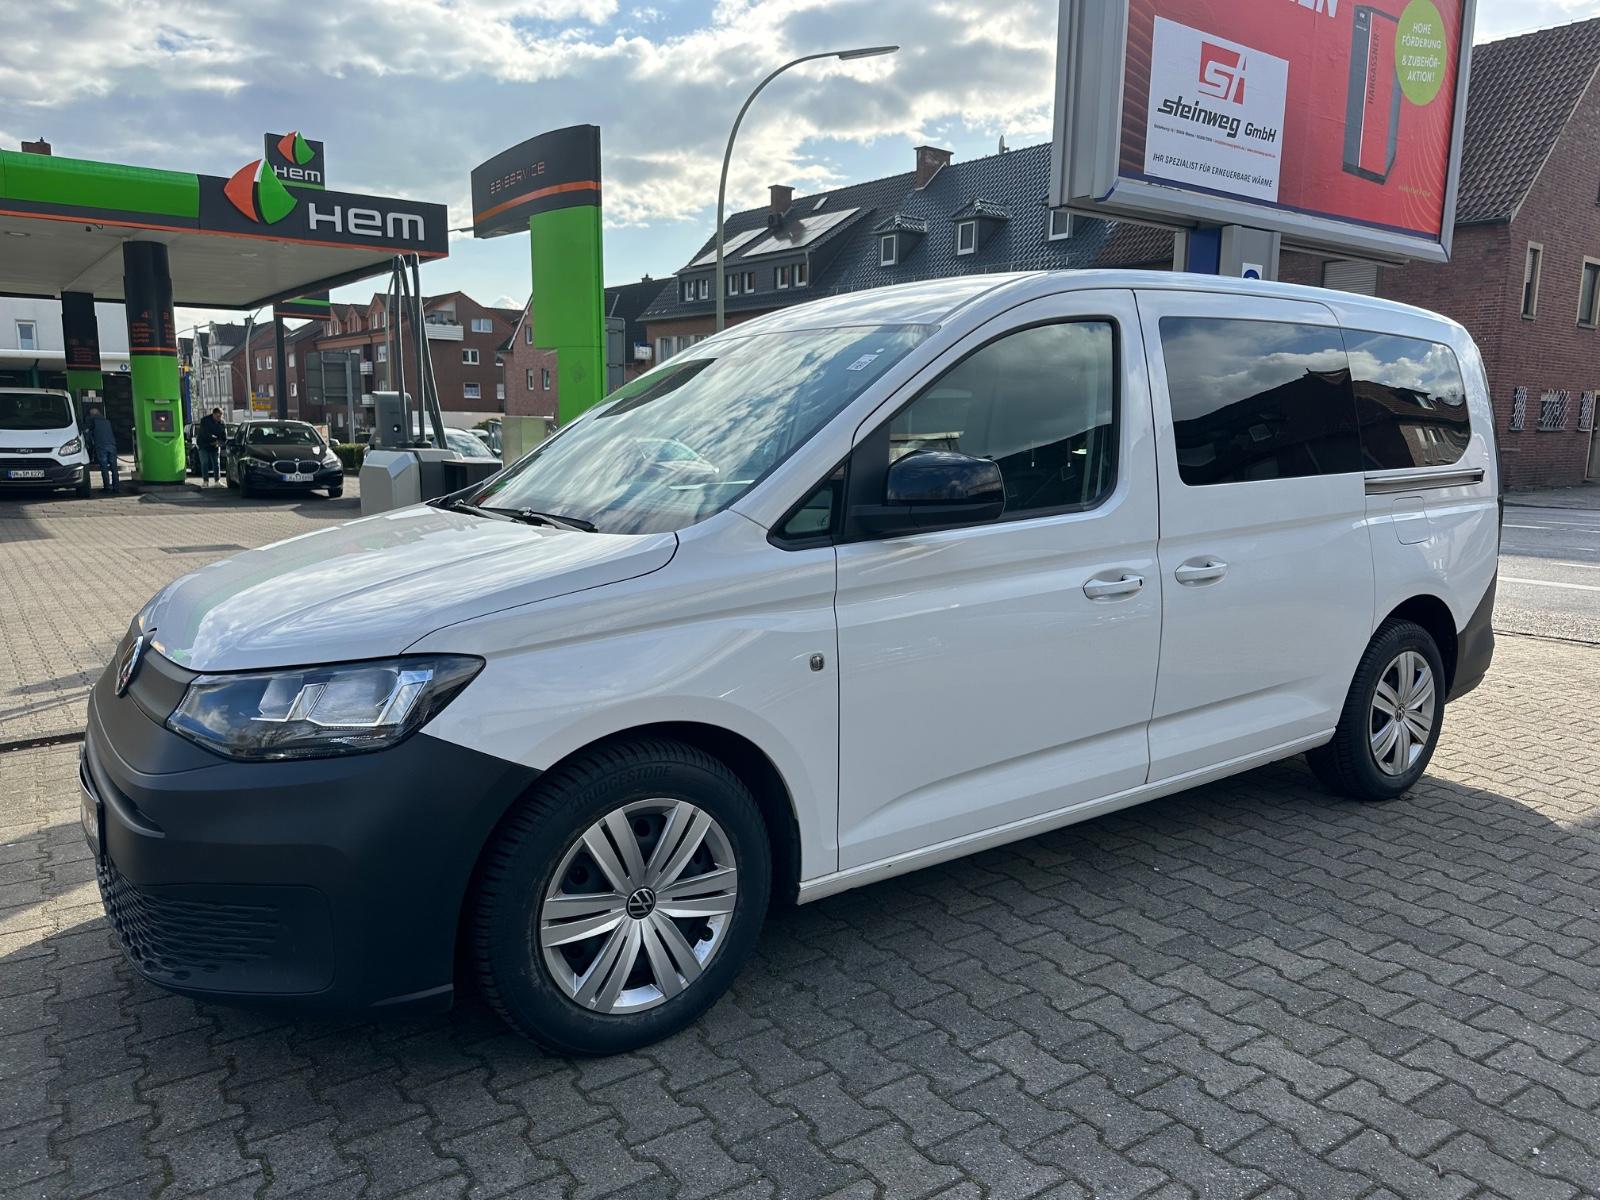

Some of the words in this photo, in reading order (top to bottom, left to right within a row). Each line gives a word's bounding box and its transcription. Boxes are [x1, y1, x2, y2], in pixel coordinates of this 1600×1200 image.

[1157, 95, 1241, 138] steinweg
[1244, 122, 1277, 143] GmbH
[1153, 153, 1164, 163] IHR
[1165, 155, 1199, 171] SPEZIALIST
[1199, 163, 1212, 174] FÜR
[1212, 166, 1251, 183] ERNEUERBARE
[1253, 174, 1273, 187] WÄRME
